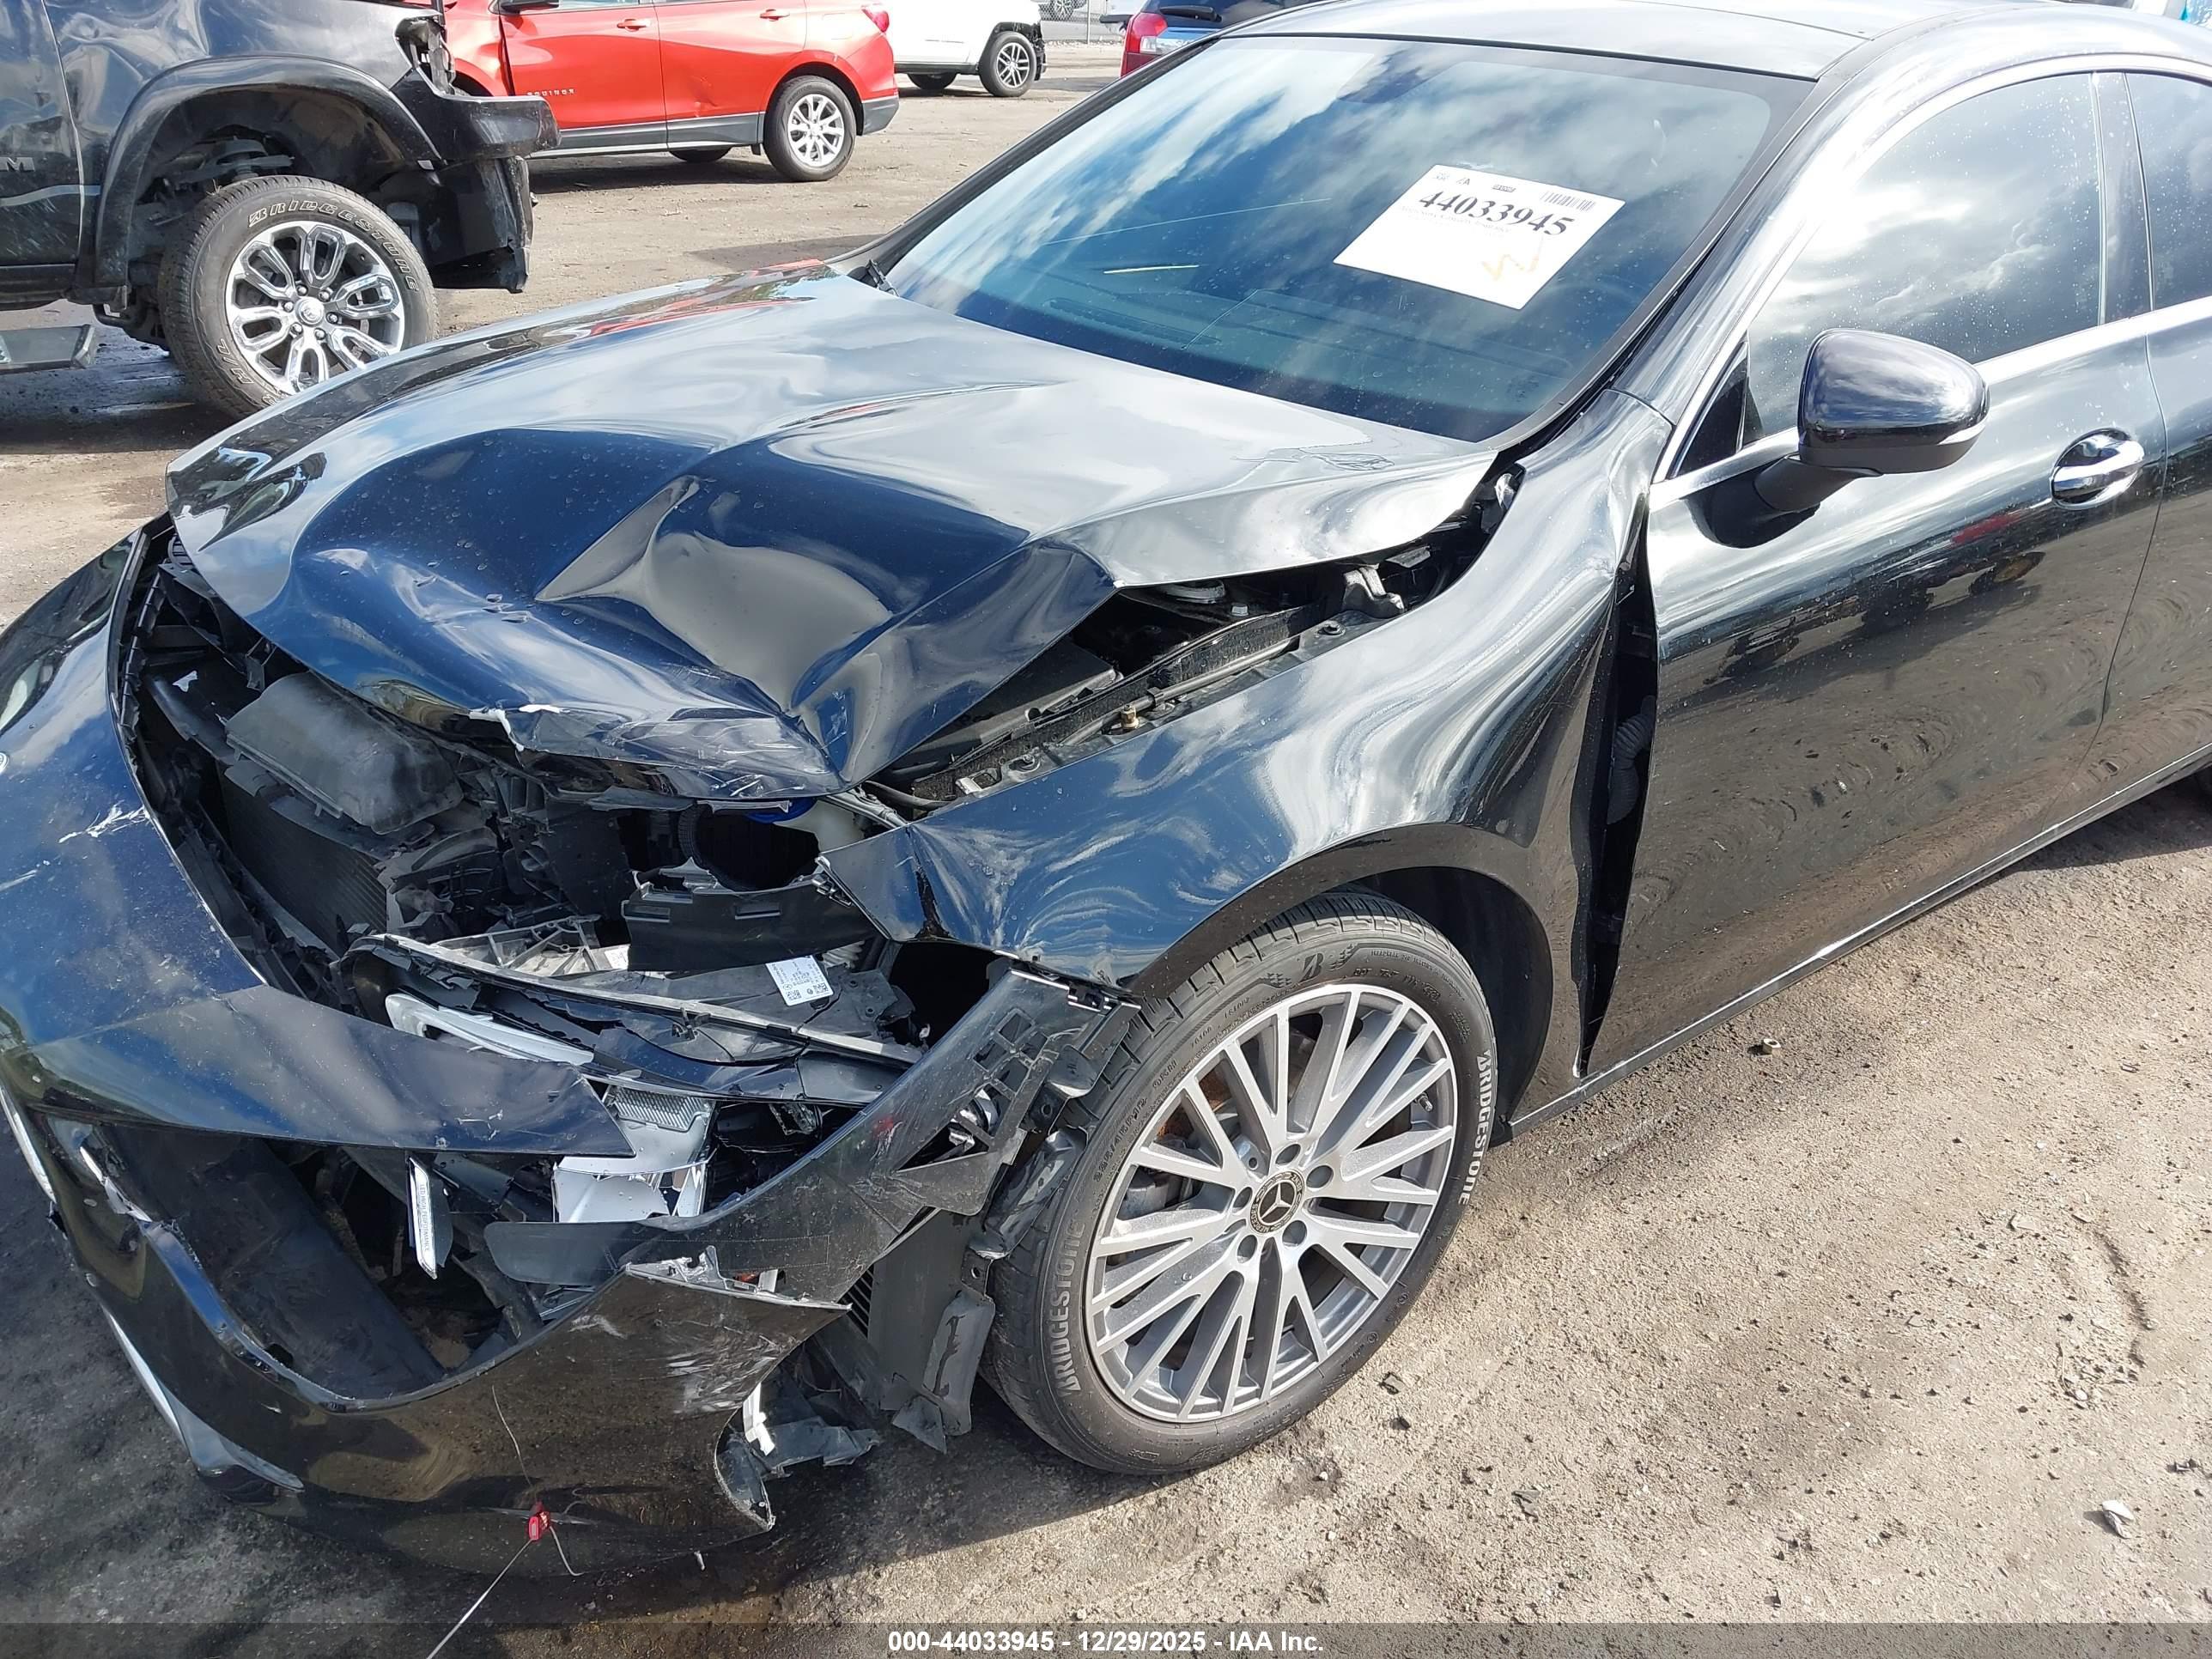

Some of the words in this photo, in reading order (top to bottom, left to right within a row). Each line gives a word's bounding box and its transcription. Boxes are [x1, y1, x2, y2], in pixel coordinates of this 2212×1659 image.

[249, 199, 419, 291] BRIDGESTONE
[1419, 191, 1576, 235] 44033945
[1458, 1048, 1492, 1206] BRIDGESTONE
[1048, 1222, 1086, 1398] BRIDGESTONE
